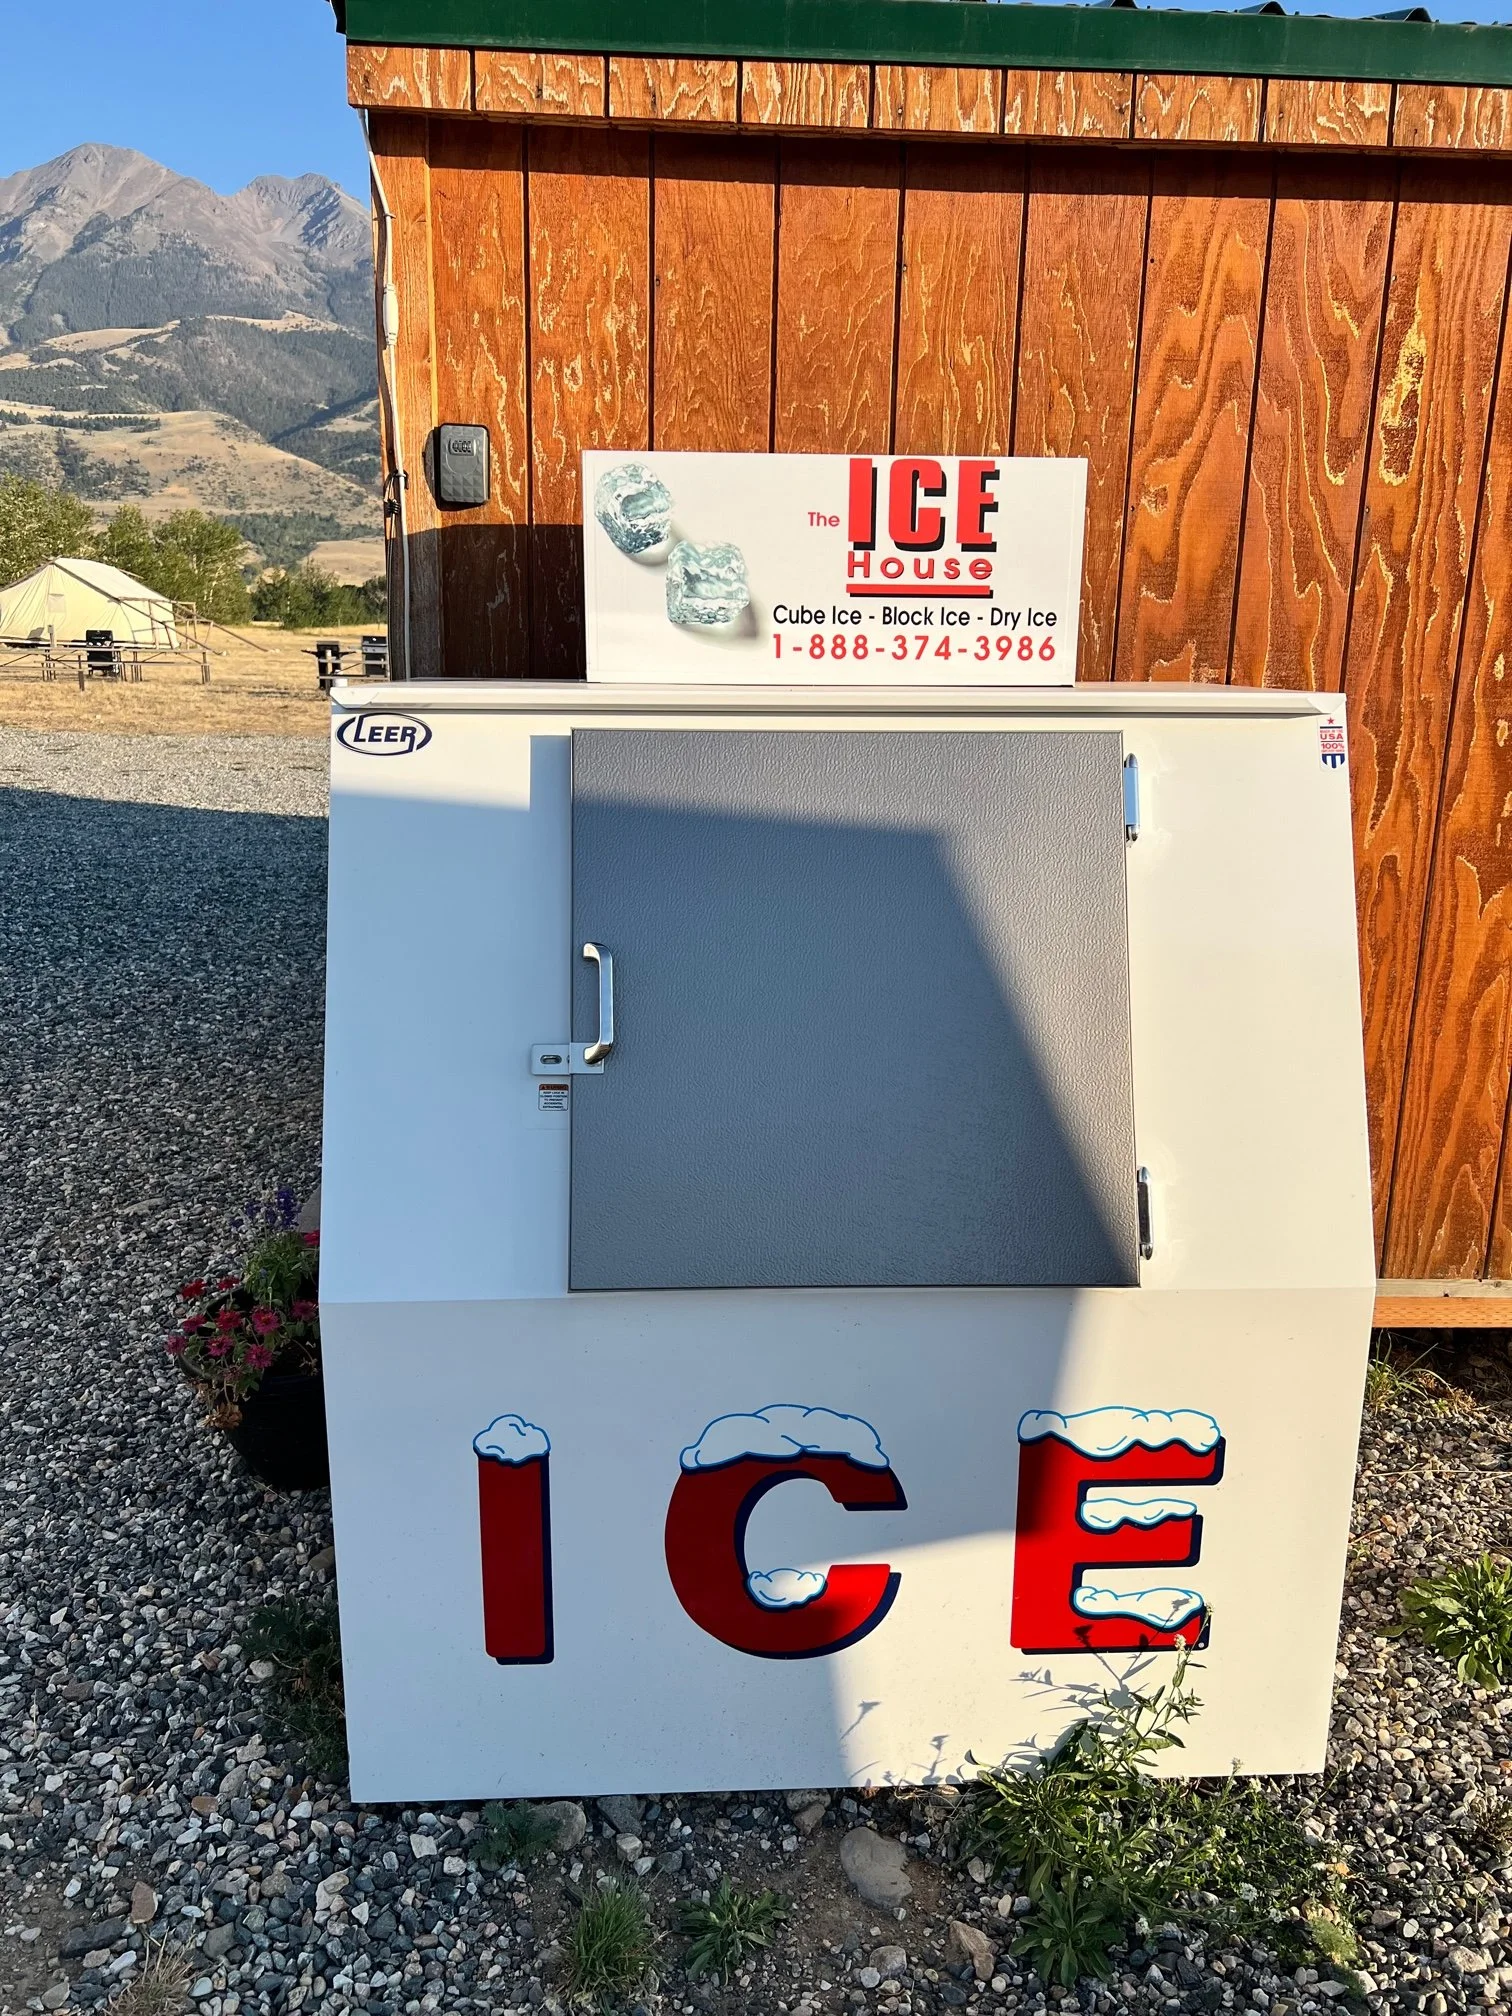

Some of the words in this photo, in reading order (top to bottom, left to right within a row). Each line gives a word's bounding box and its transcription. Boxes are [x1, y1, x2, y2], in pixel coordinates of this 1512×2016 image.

[808, 511, 840, 528] The
[848, 457, 1001, 552] ICE
[848, 551, 994, 580] House
[773, 604, 826, 624] Cube
[832, 605, 862, 625] Ice
[882, 606, 934, 626] Block
[941, 607, 971, 626] Ice
[990, 607, 1021, 630] Dry
[1027, 607, 1057, 627] Ice
[773, 633, 1056, 661] 1-888-374-3986
[353, 715, 417, 752] LEER
[472, 1404, 1226, 1665] ICE
